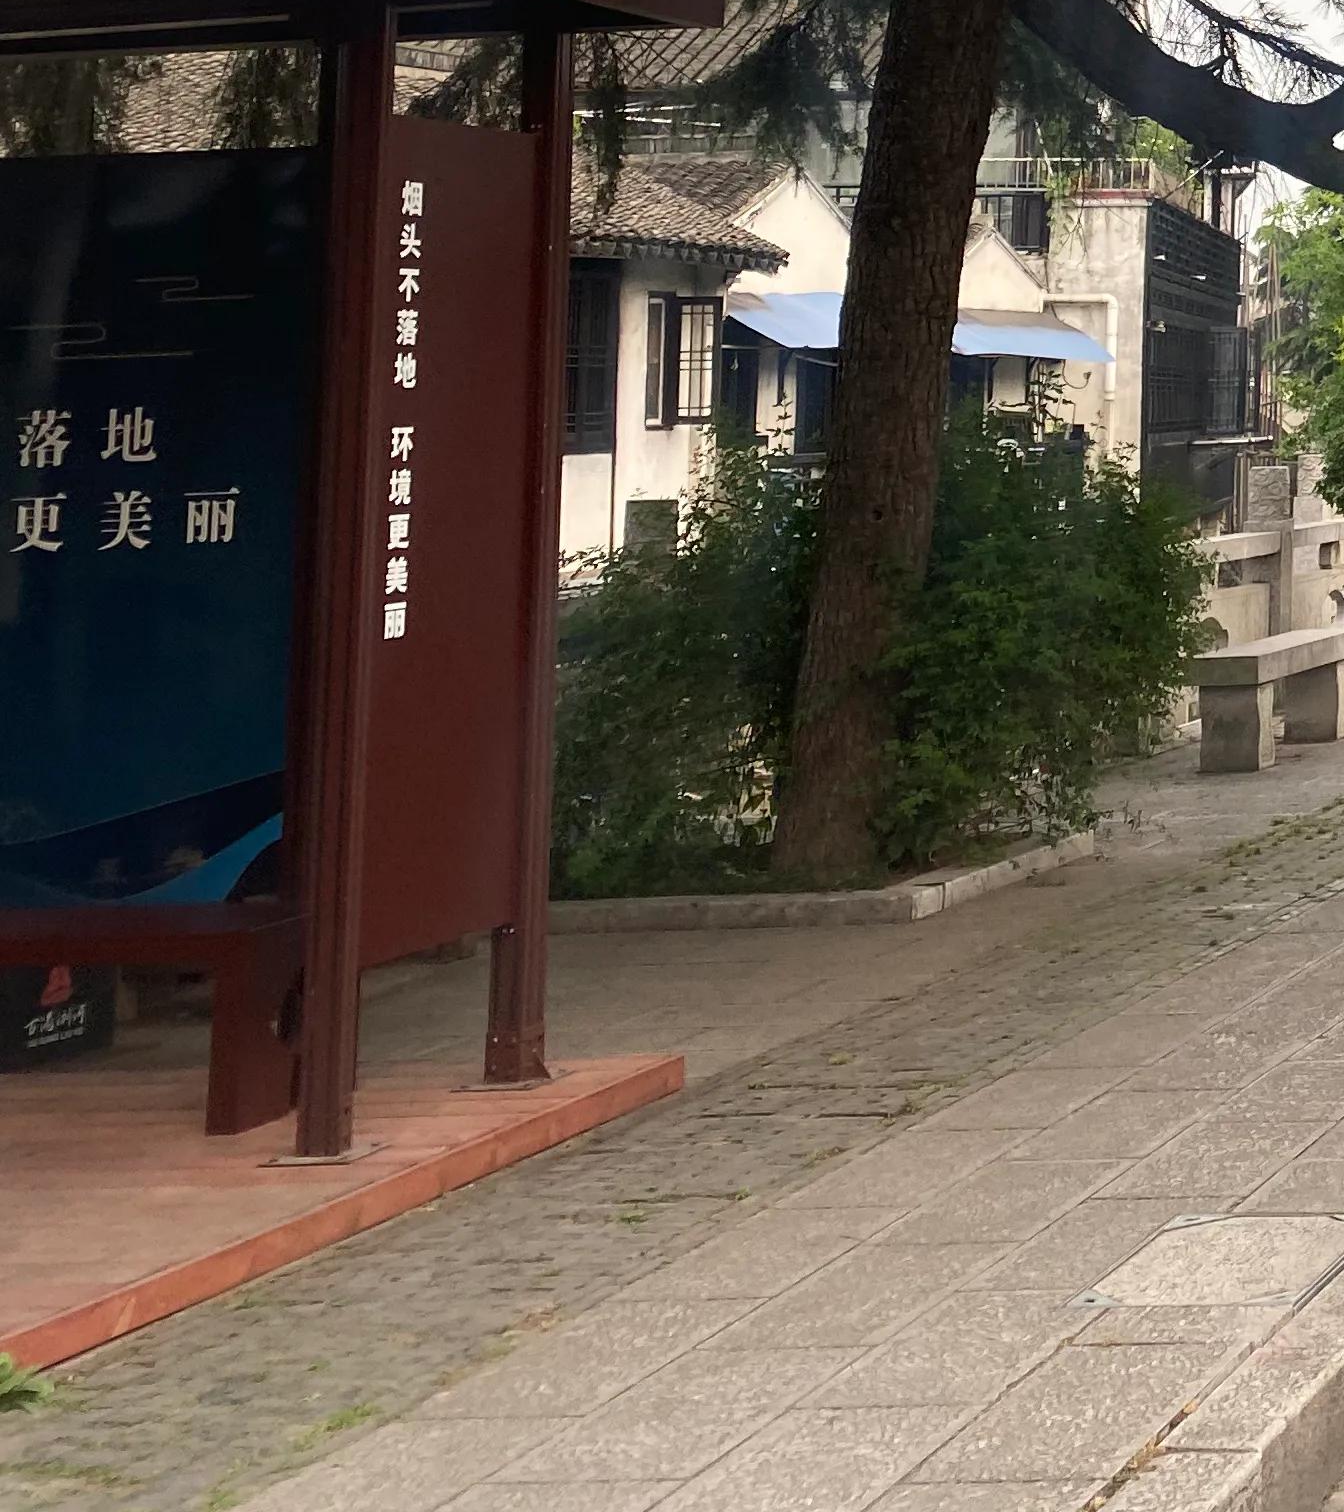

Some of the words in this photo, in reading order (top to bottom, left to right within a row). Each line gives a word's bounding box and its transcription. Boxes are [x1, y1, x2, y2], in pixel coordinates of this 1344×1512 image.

[394, 180, 424, 389] 烟头不落地
[16, 406, 157, 469] 落地
[9, 487, 241, 553] 更美丽
[383, 426, 415, 640] 环境更美丽
